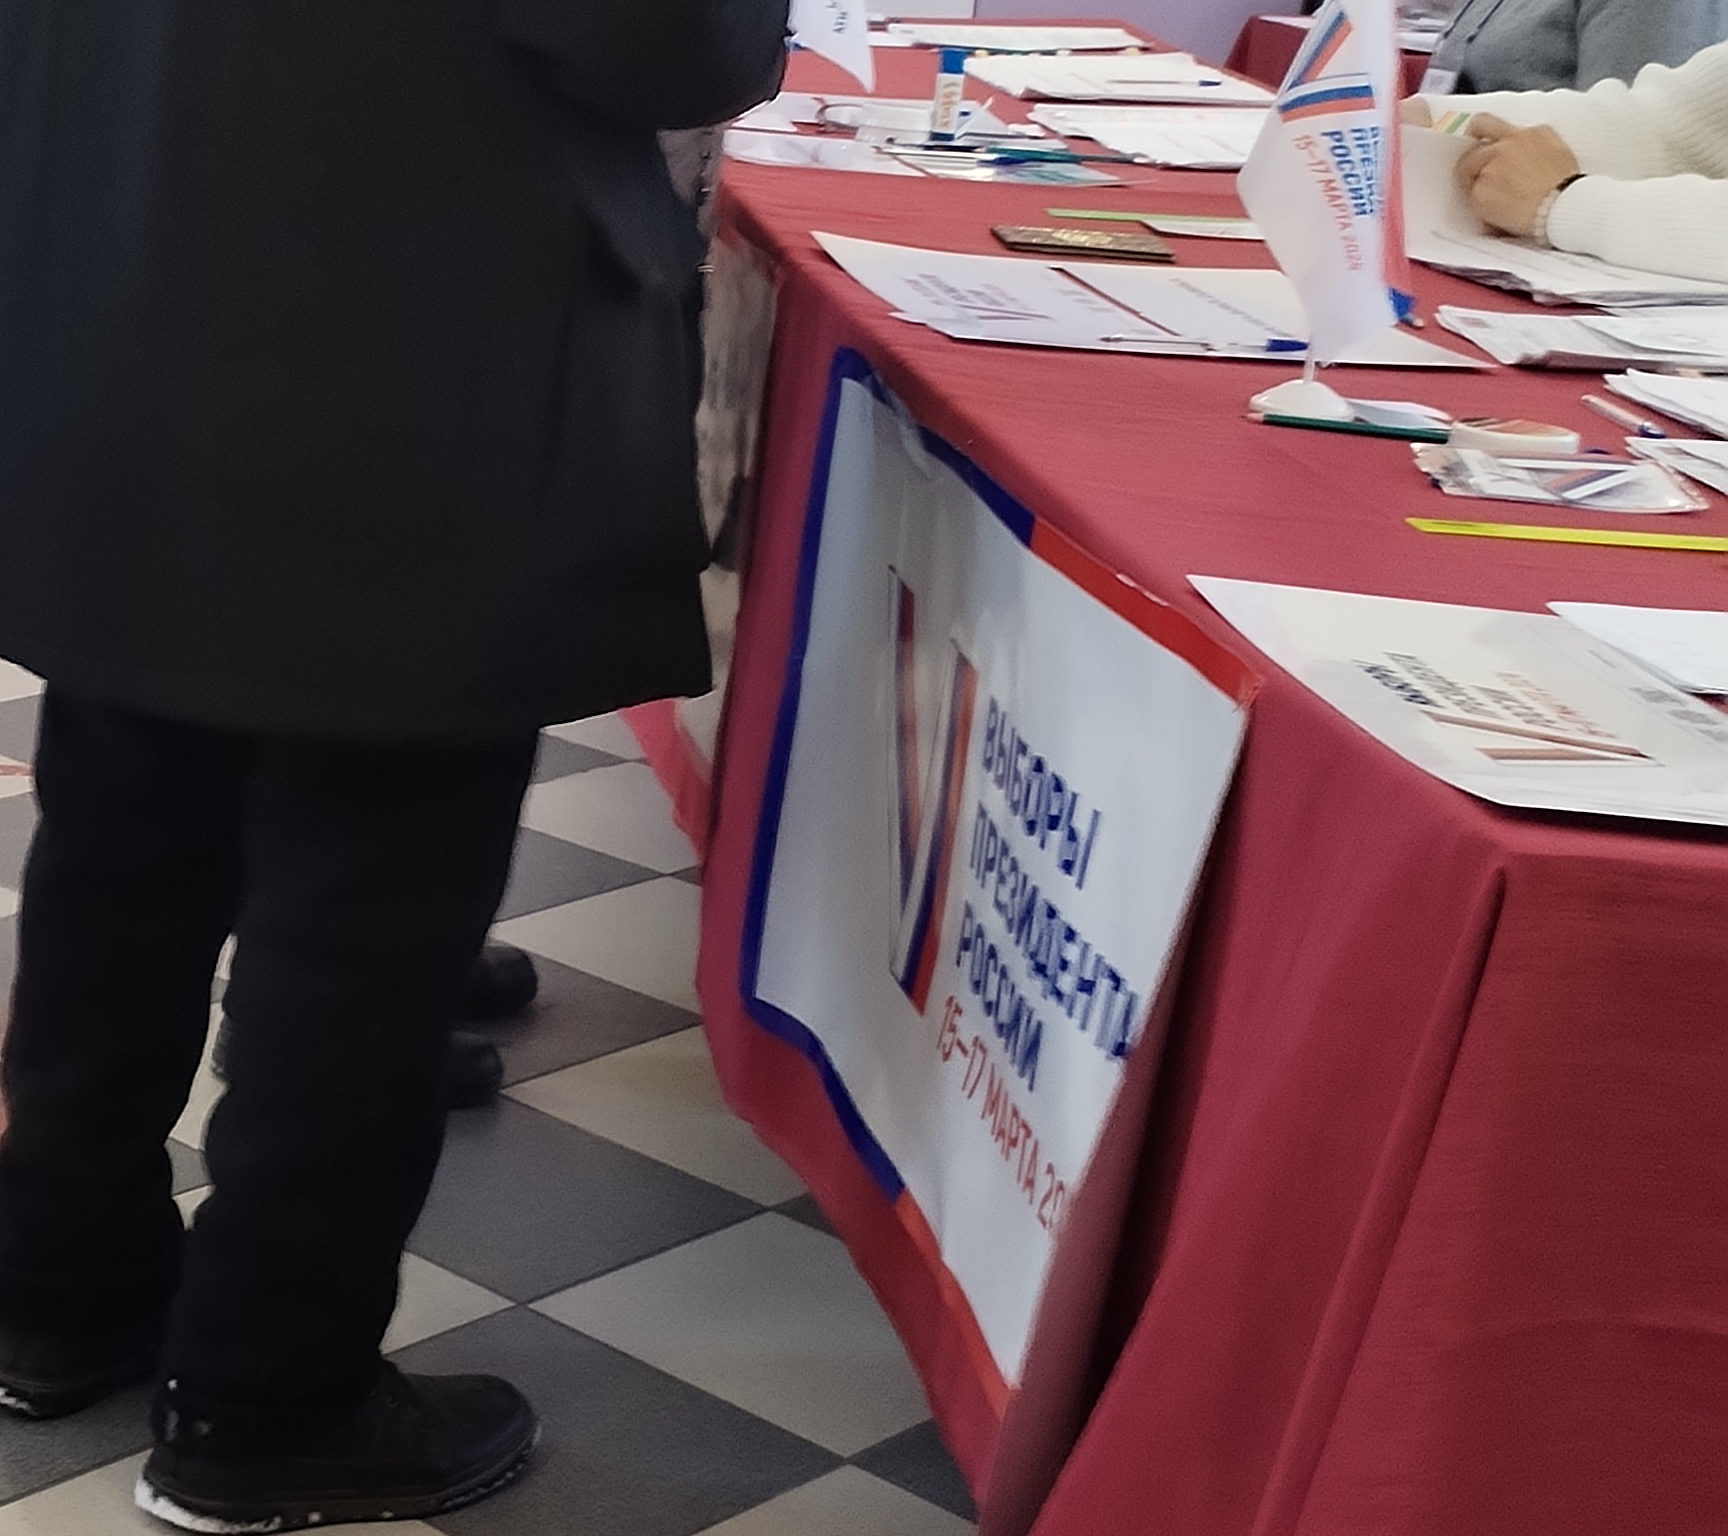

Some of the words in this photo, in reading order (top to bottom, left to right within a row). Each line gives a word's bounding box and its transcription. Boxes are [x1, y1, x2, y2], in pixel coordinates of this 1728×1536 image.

[982, 695, 1101, 891] ВЫБОРЫ
[956, 899, 1043, 1093] РОССИИ
[980, 1061, 1039, 1206] МАРТА
